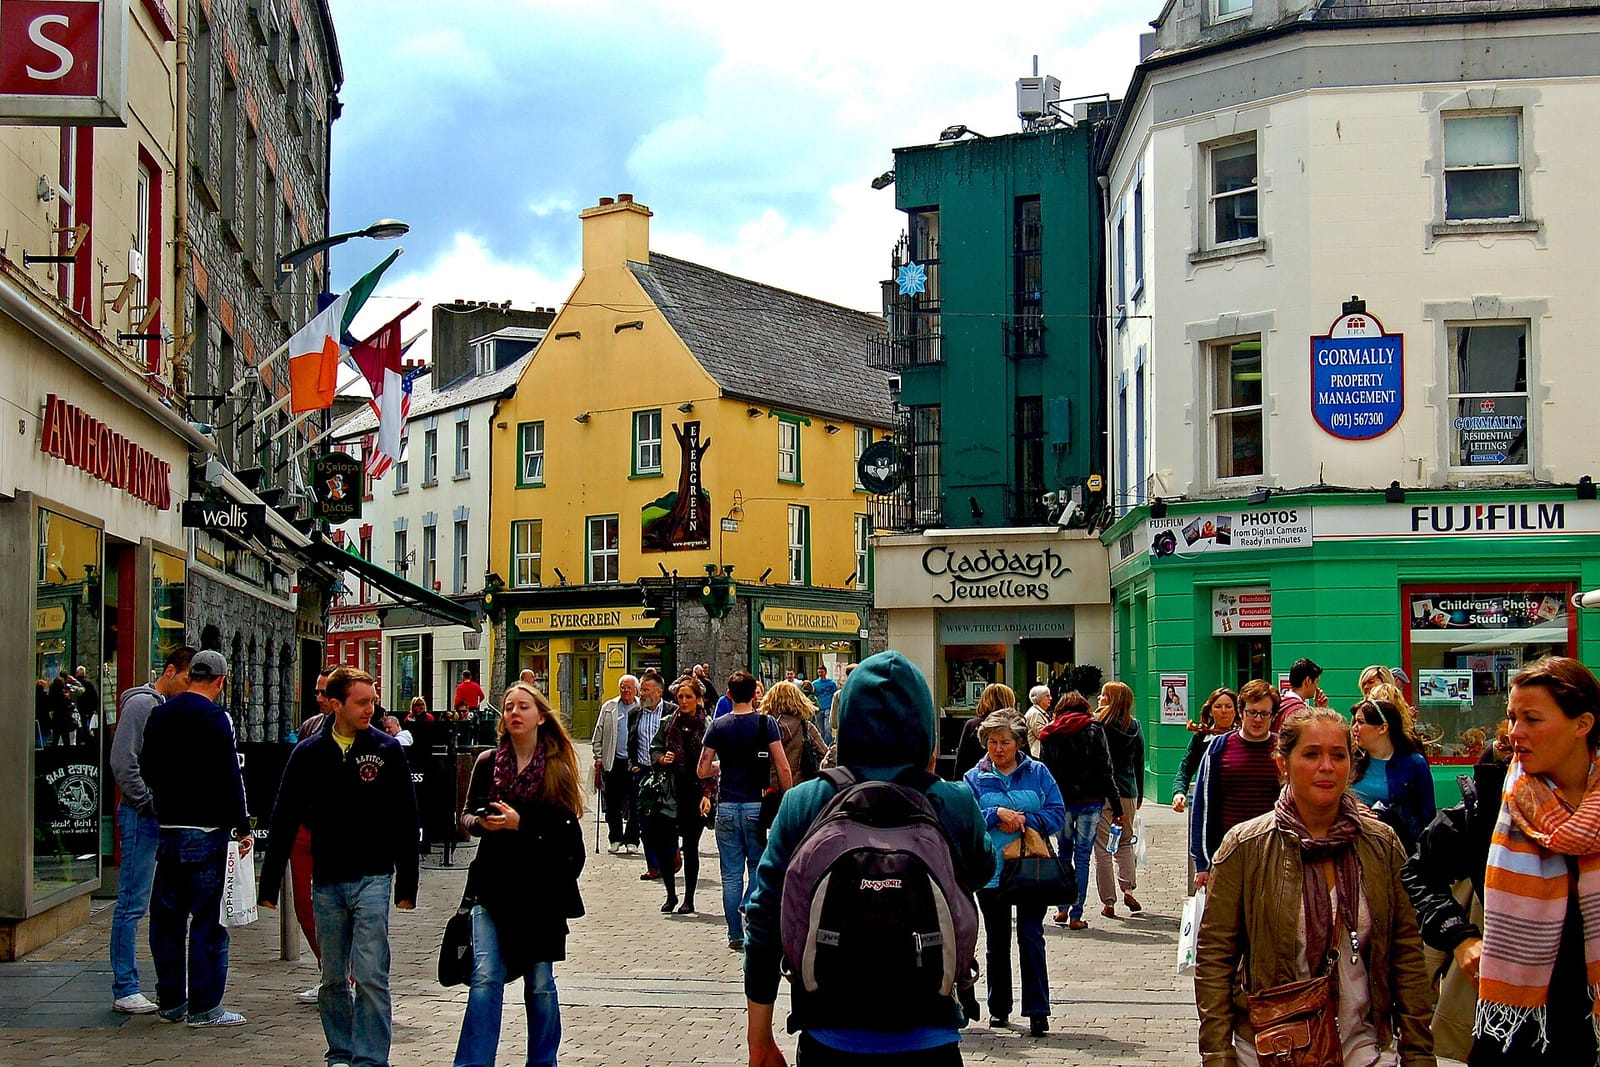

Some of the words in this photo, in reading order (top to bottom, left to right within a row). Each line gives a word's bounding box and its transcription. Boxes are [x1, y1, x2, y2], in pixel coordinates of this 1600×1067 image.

[25, 14, 74, 80] S
[1318, 348, 1395, 366] GORMALLY
[1330, 374, 1384, 388] PROPERTY
[1319, 390, 1396, 405] MANAGEMENT
[1331, 412, 1352, 430] (091)
[1353, 412, 1384, 426] 567300
[1453, 415, 1523, 431] GORMALLY
[41, 393, 129, 490] ANTHONY
[1464, 432, 1513, 441] RESIDENTIAL
[1470, 442, 1507, 451] LETTINGS
[689, 426, 697, 531] EVERGREEN
[1149, 519, 1184, 529] FUJIFILM
[1241, 510, 1298, 526] PHOTOS
[1411, 503, 1565, 532] FUJIFILM
[1233, 528, 1251, 537] from
[1251, 526, 1276, 537] Digital
[1276, 526, 1308, 536] Cameras
[1241, 538, 1262, 547] Ready
[1263, 537, 1271, 545] in
[1272, 536, 1301, 545] minutes
[922, 546, 1072, 582] Claddagh
[933, 579, 1049, 603] Jewellers
[1438, 600, 1498, 610] Children's
[1502, 599, 1539, 610] Photo
[521, 617, 544, 625] HEALTH
[550, 611, 621, 628] EVERGREEN
[786, 611, 839, 629] EVERGREEN
[946, 623, 1065, 632] WWW.THECLADDAGH.COM
[1468, 614, 1508, 625] Studio
[226, 851, 235, 919] TOPMAN.COM
[860, 878, 902, 891] JANSPORT
